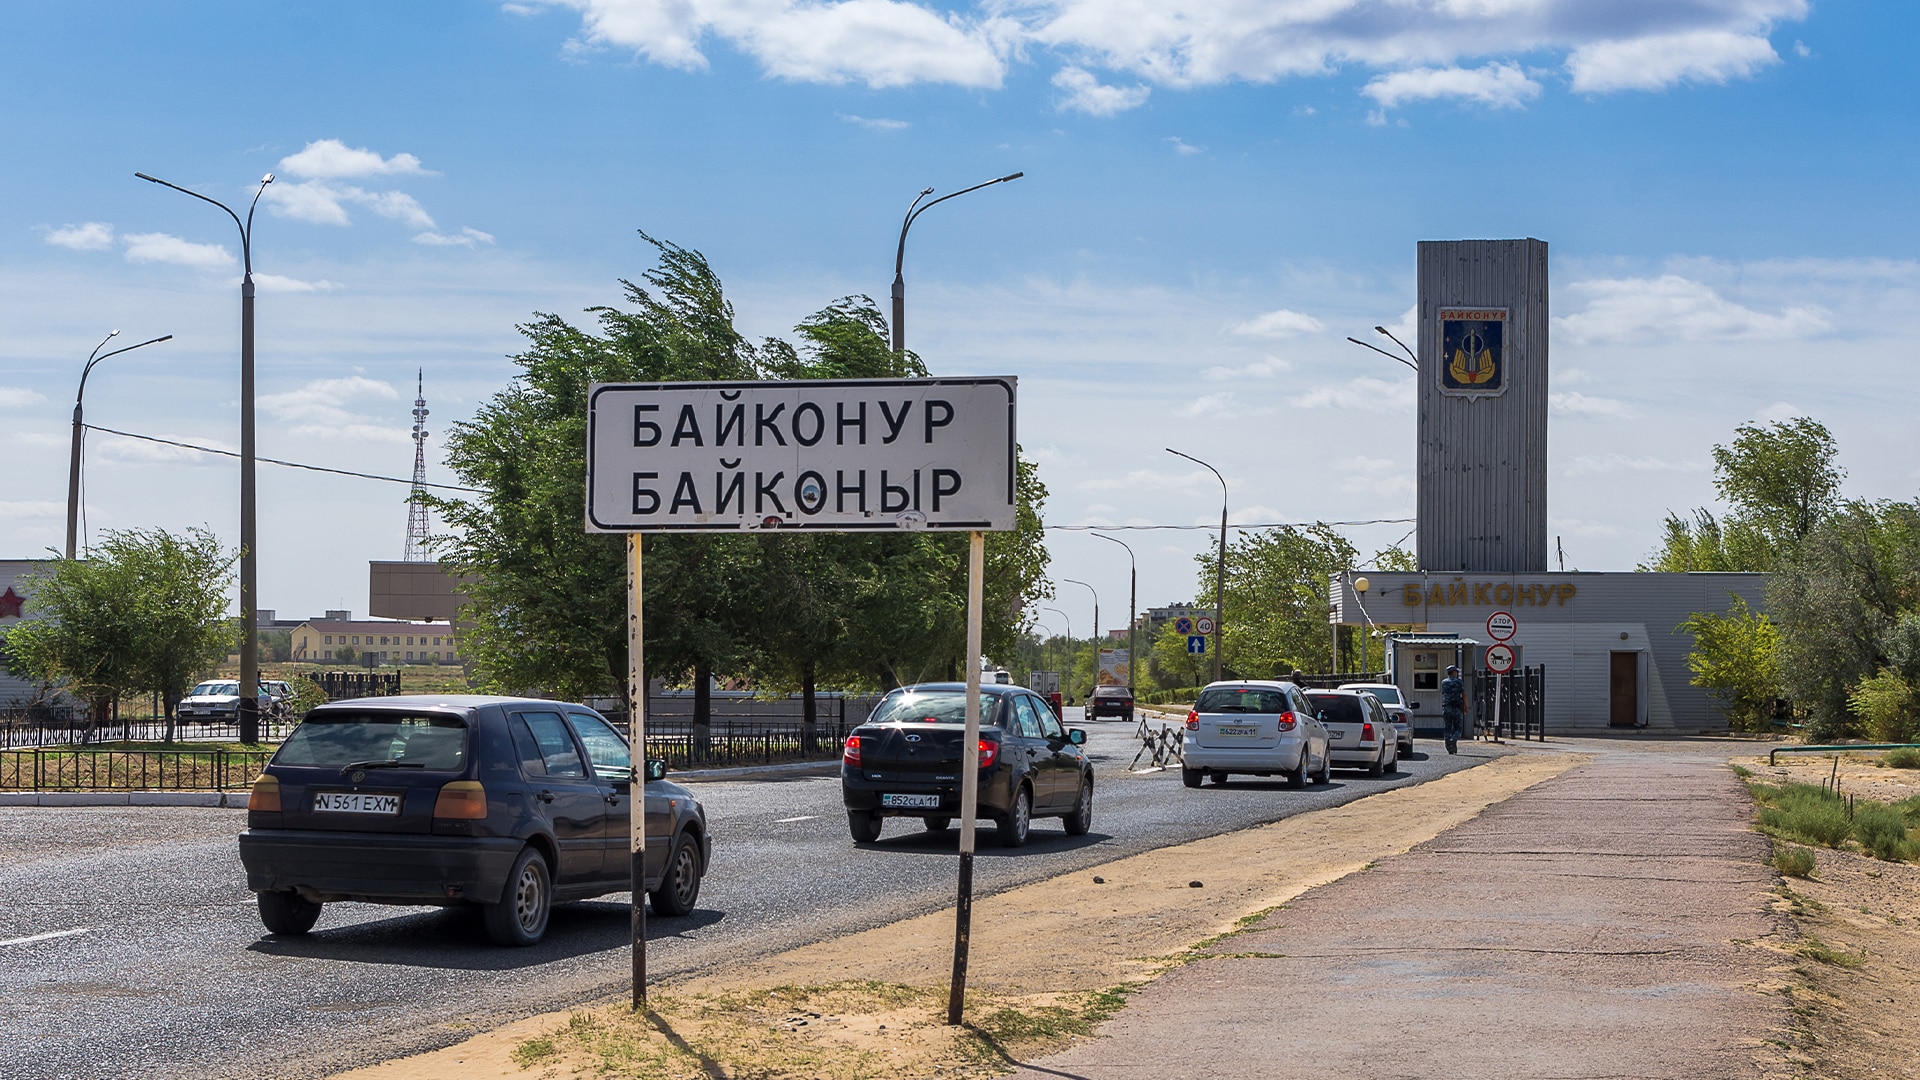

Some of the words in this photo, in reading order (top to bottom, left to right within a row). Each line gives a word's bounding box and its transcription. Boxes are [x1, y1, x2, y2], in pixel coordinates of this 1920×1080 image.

[1441, 311, 1506, 319] БАЙКОНУР
[633, 390, 955, 448] БАЙКОНУР
[1403, 577, 1578, 607] БАЙКОНУР
[1199, 622, 1211, 631] 40
[318, 794, 330, 809] N
[334, 795, 359, 810] 561
[363, 796, 396, 812] EXM
[926, 796, 937, 806] 11
